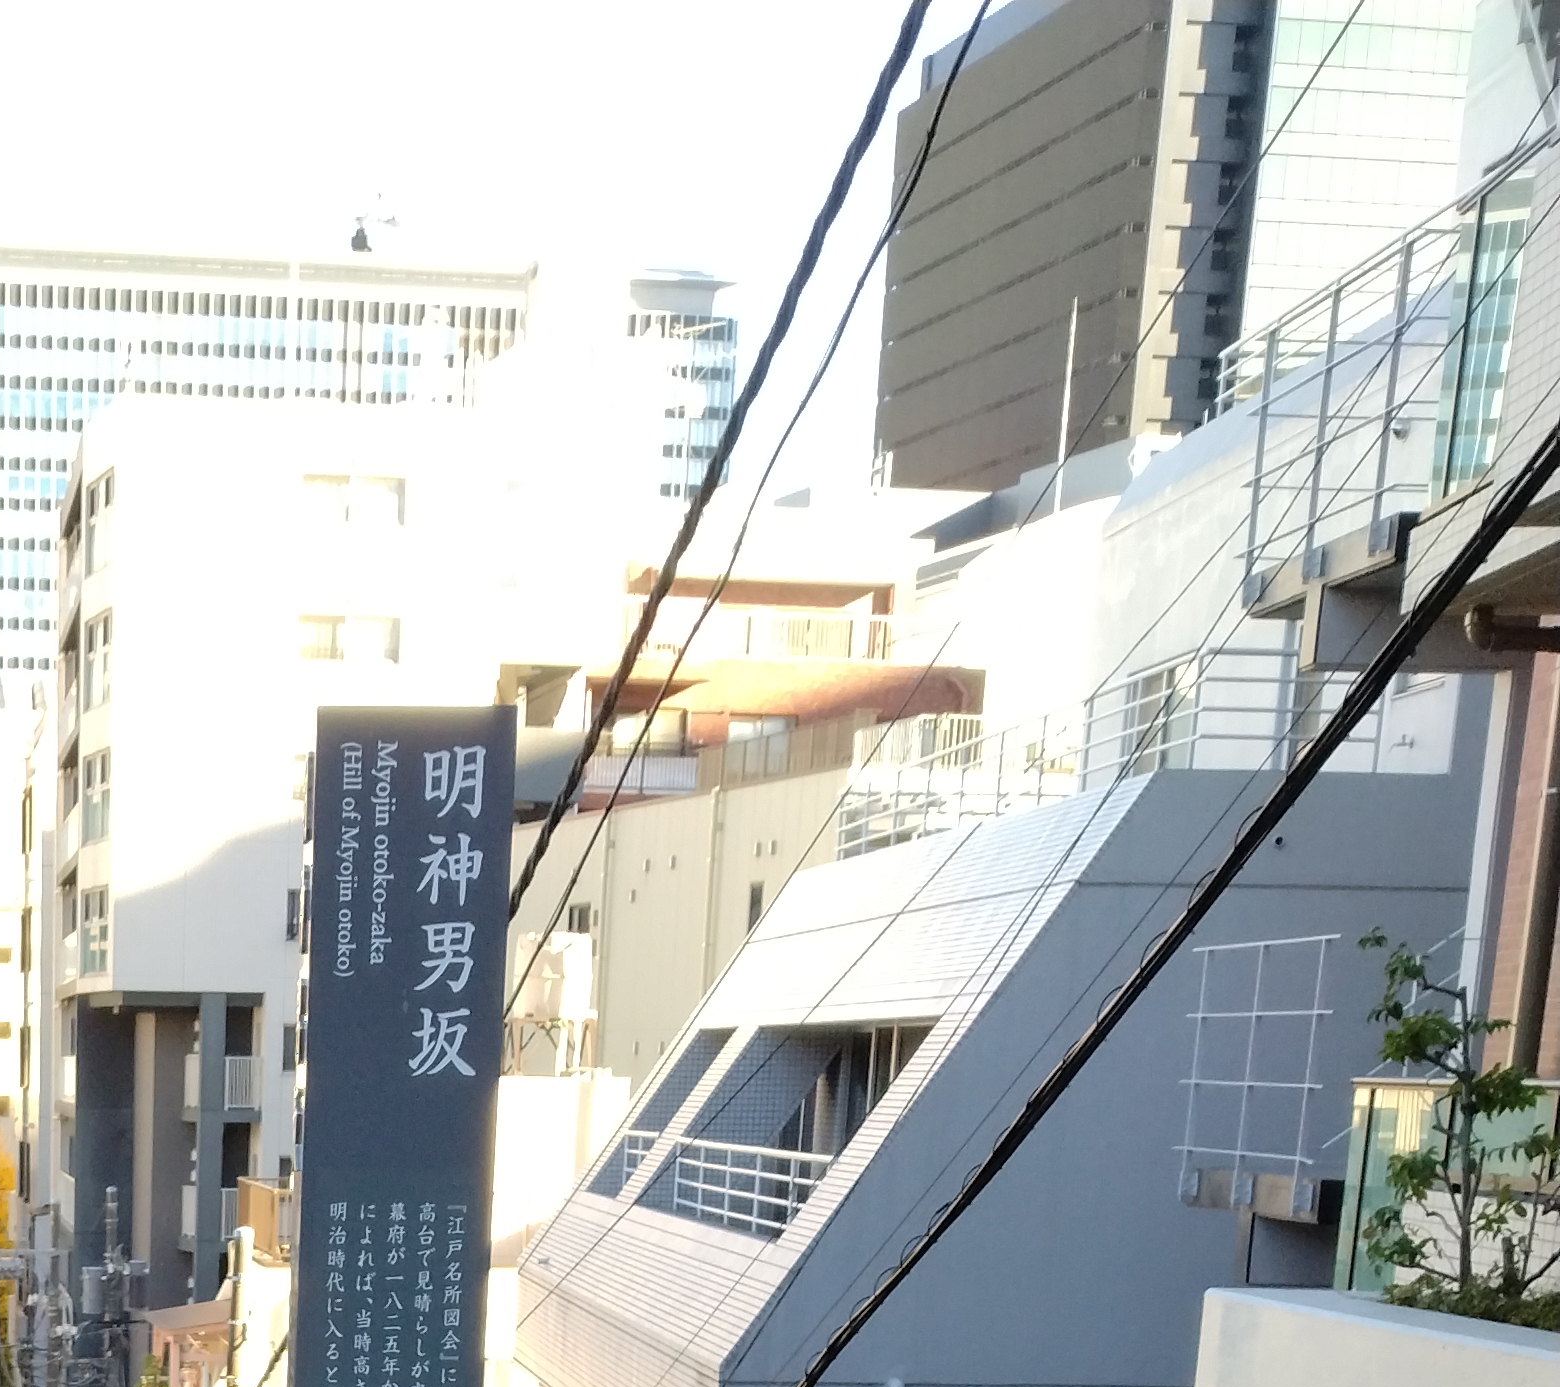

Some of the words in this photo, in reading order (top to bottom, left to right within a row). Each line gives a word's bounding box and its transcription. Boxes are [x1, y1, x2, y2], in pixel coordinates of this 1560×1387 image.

[340, 741, 363, 791] (Hill
[370, 739, 399, 828] Myojin
[341, 796, 362, 822] of
[335, 825, 360, 903] Myojin
[369, 834, 395, 966] otoko-zaka
[332, 908, 357, 978] otoko)
[407, 743, 487, 1078] 明神男坂
